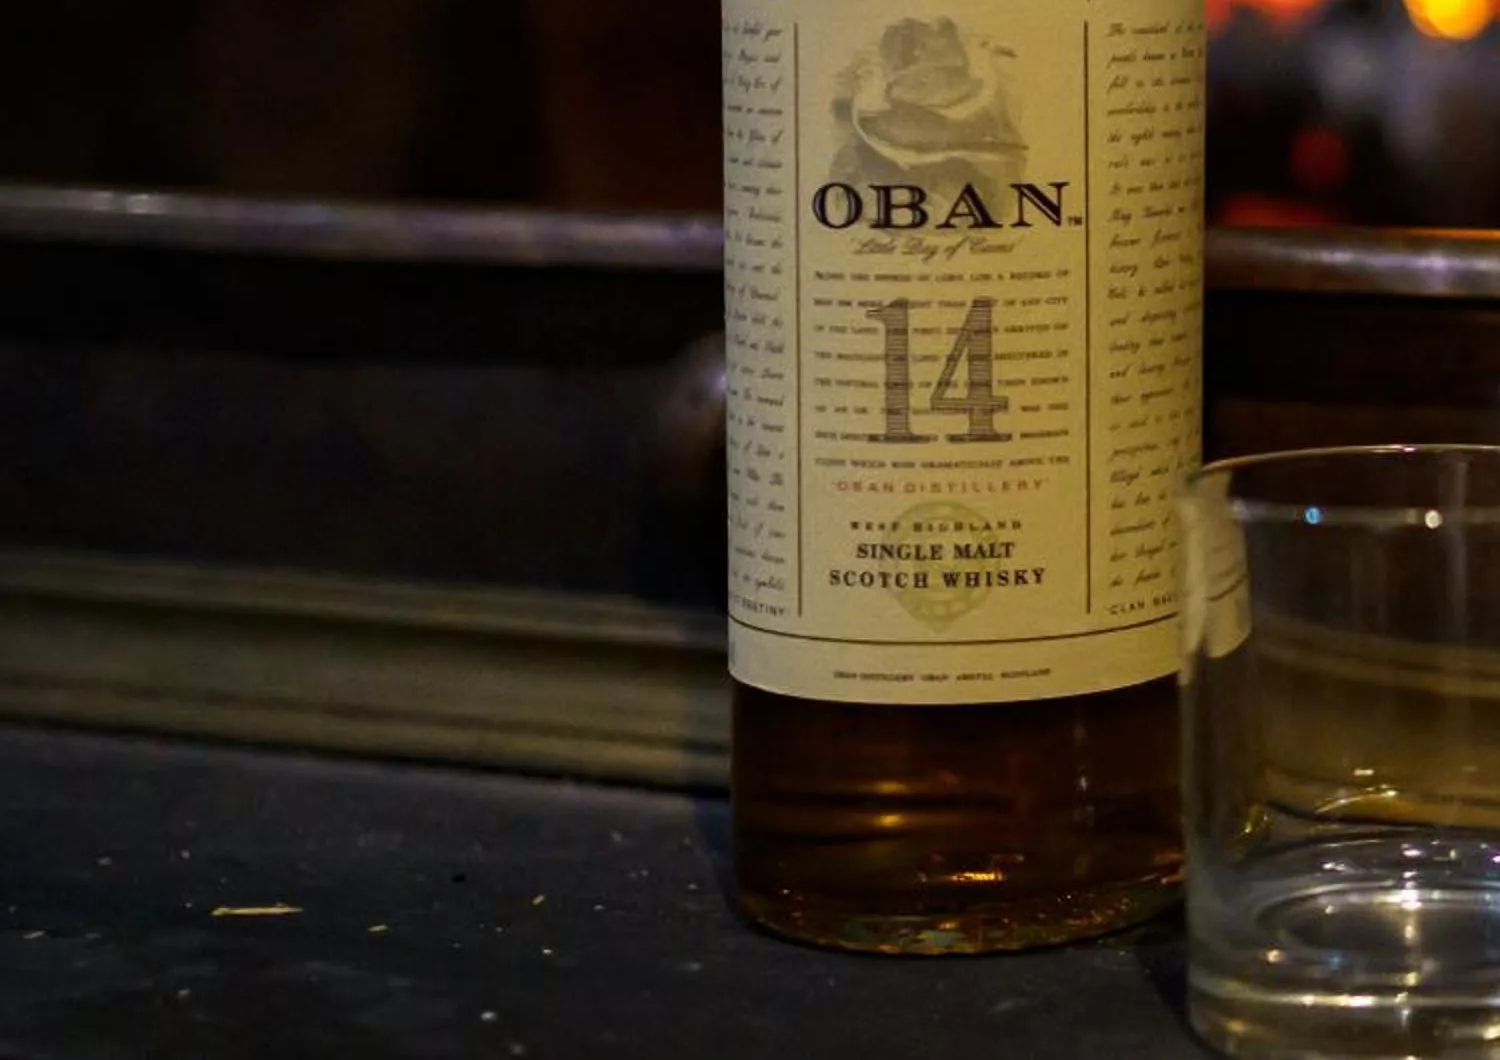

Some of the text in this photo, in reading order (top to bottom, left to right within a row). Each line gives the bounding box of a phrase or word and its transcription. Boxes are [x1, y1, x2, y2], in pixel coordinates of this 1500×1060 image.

[812, 181, 1069, 229] OBAN
[865, 295, 1012, 443] 14
[856, 542, 1016, 561] SINGLE MALT
[829, 567, 1048, 590] SCOTCH WHISKY
